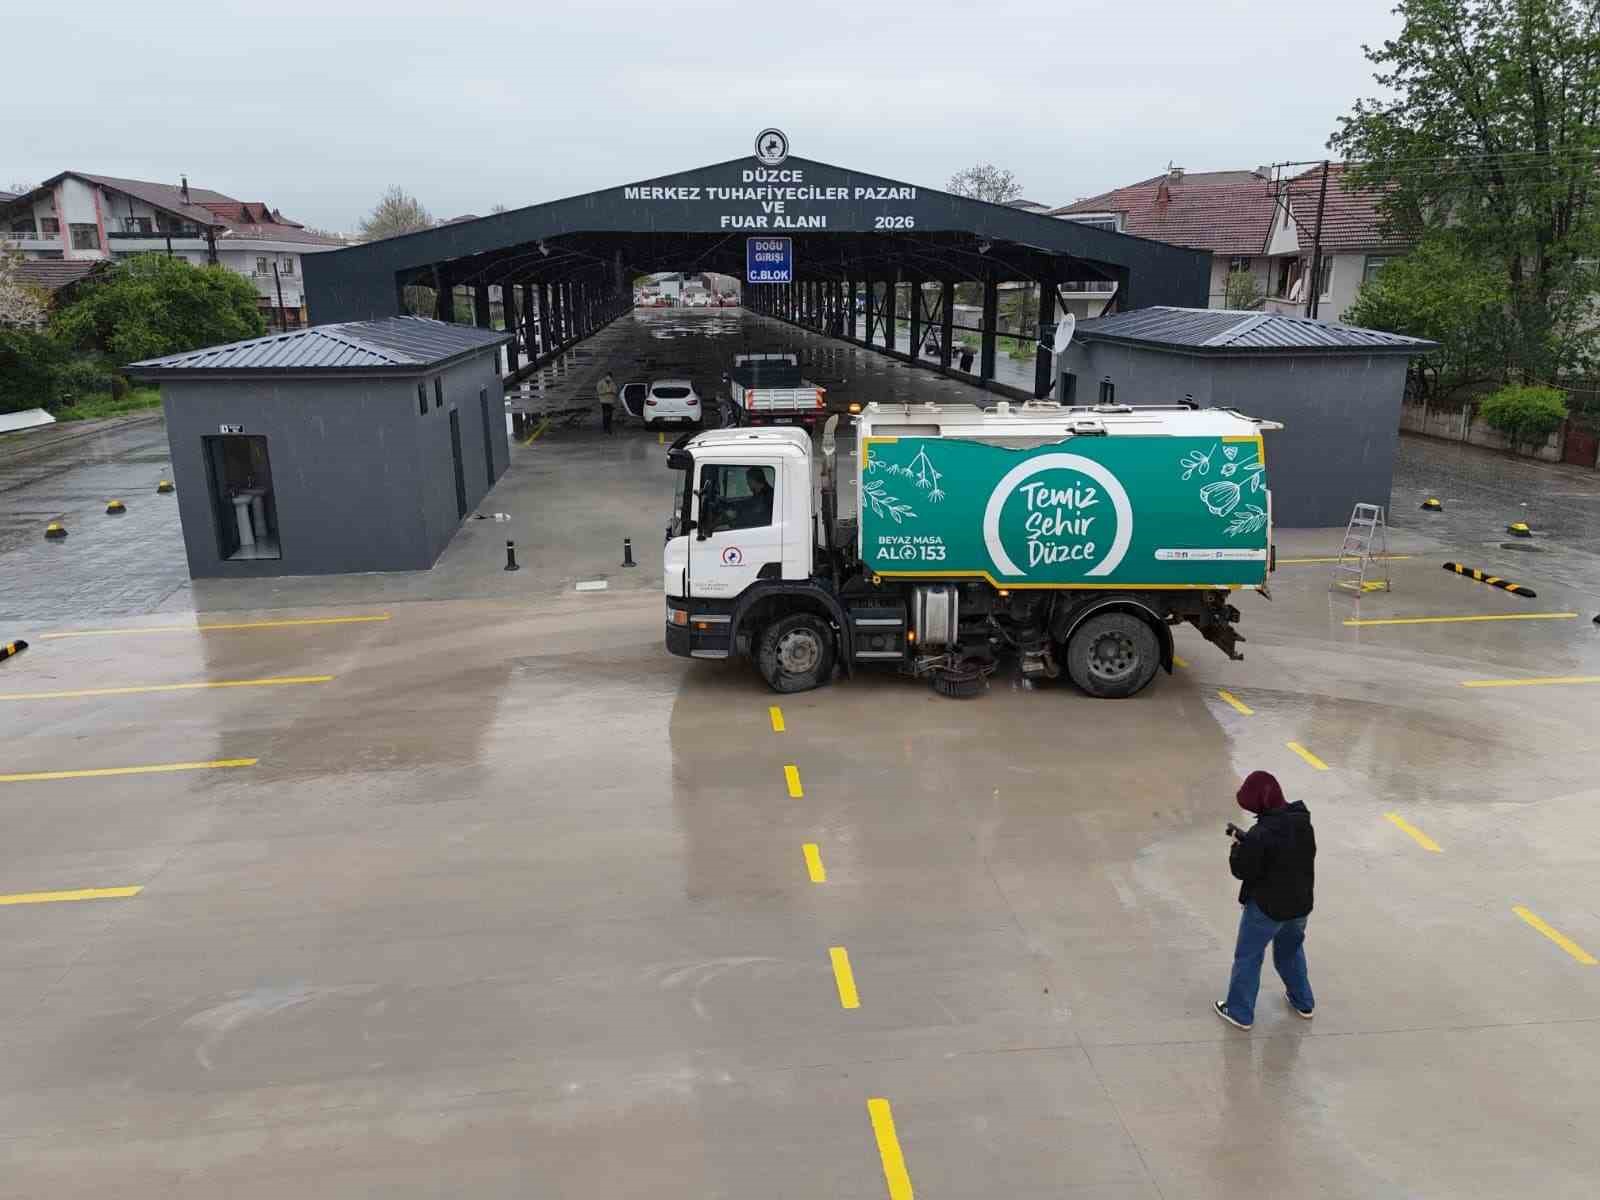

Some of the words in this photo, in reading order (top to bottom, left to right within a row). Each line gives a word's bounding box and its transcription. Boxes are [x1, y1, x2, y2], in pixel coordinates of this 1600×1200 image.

[742, 168, 803, 183] DÜZCE
[624, 187, 701, 200] MERKEZ
[705, 186, 849, 200] TUHAFİYECİLER
[854, 187, 916, 200] PAZARI
[762, 201, 785, 213] VE
[720, 216, 768, 228] FUAR
[773, 216, 827, 228] ALANI
[874, 216, 915, 229] 2026
[755, 240, 783, 251] DOĞU
[755, 252, 784, 264] GİRİŞİ
[750, 270, 789, 280] C.BLOK
[1019, 480, 1100, 511] Temiz
[1025, 507, 1096, 539] Şehir
[878, 536, 912, 544] BEYAZ
[913, 536, 943, 544] MASA
[919, 546, 946, 560] 153
[1027, 540, 1095, 568] Düzce
